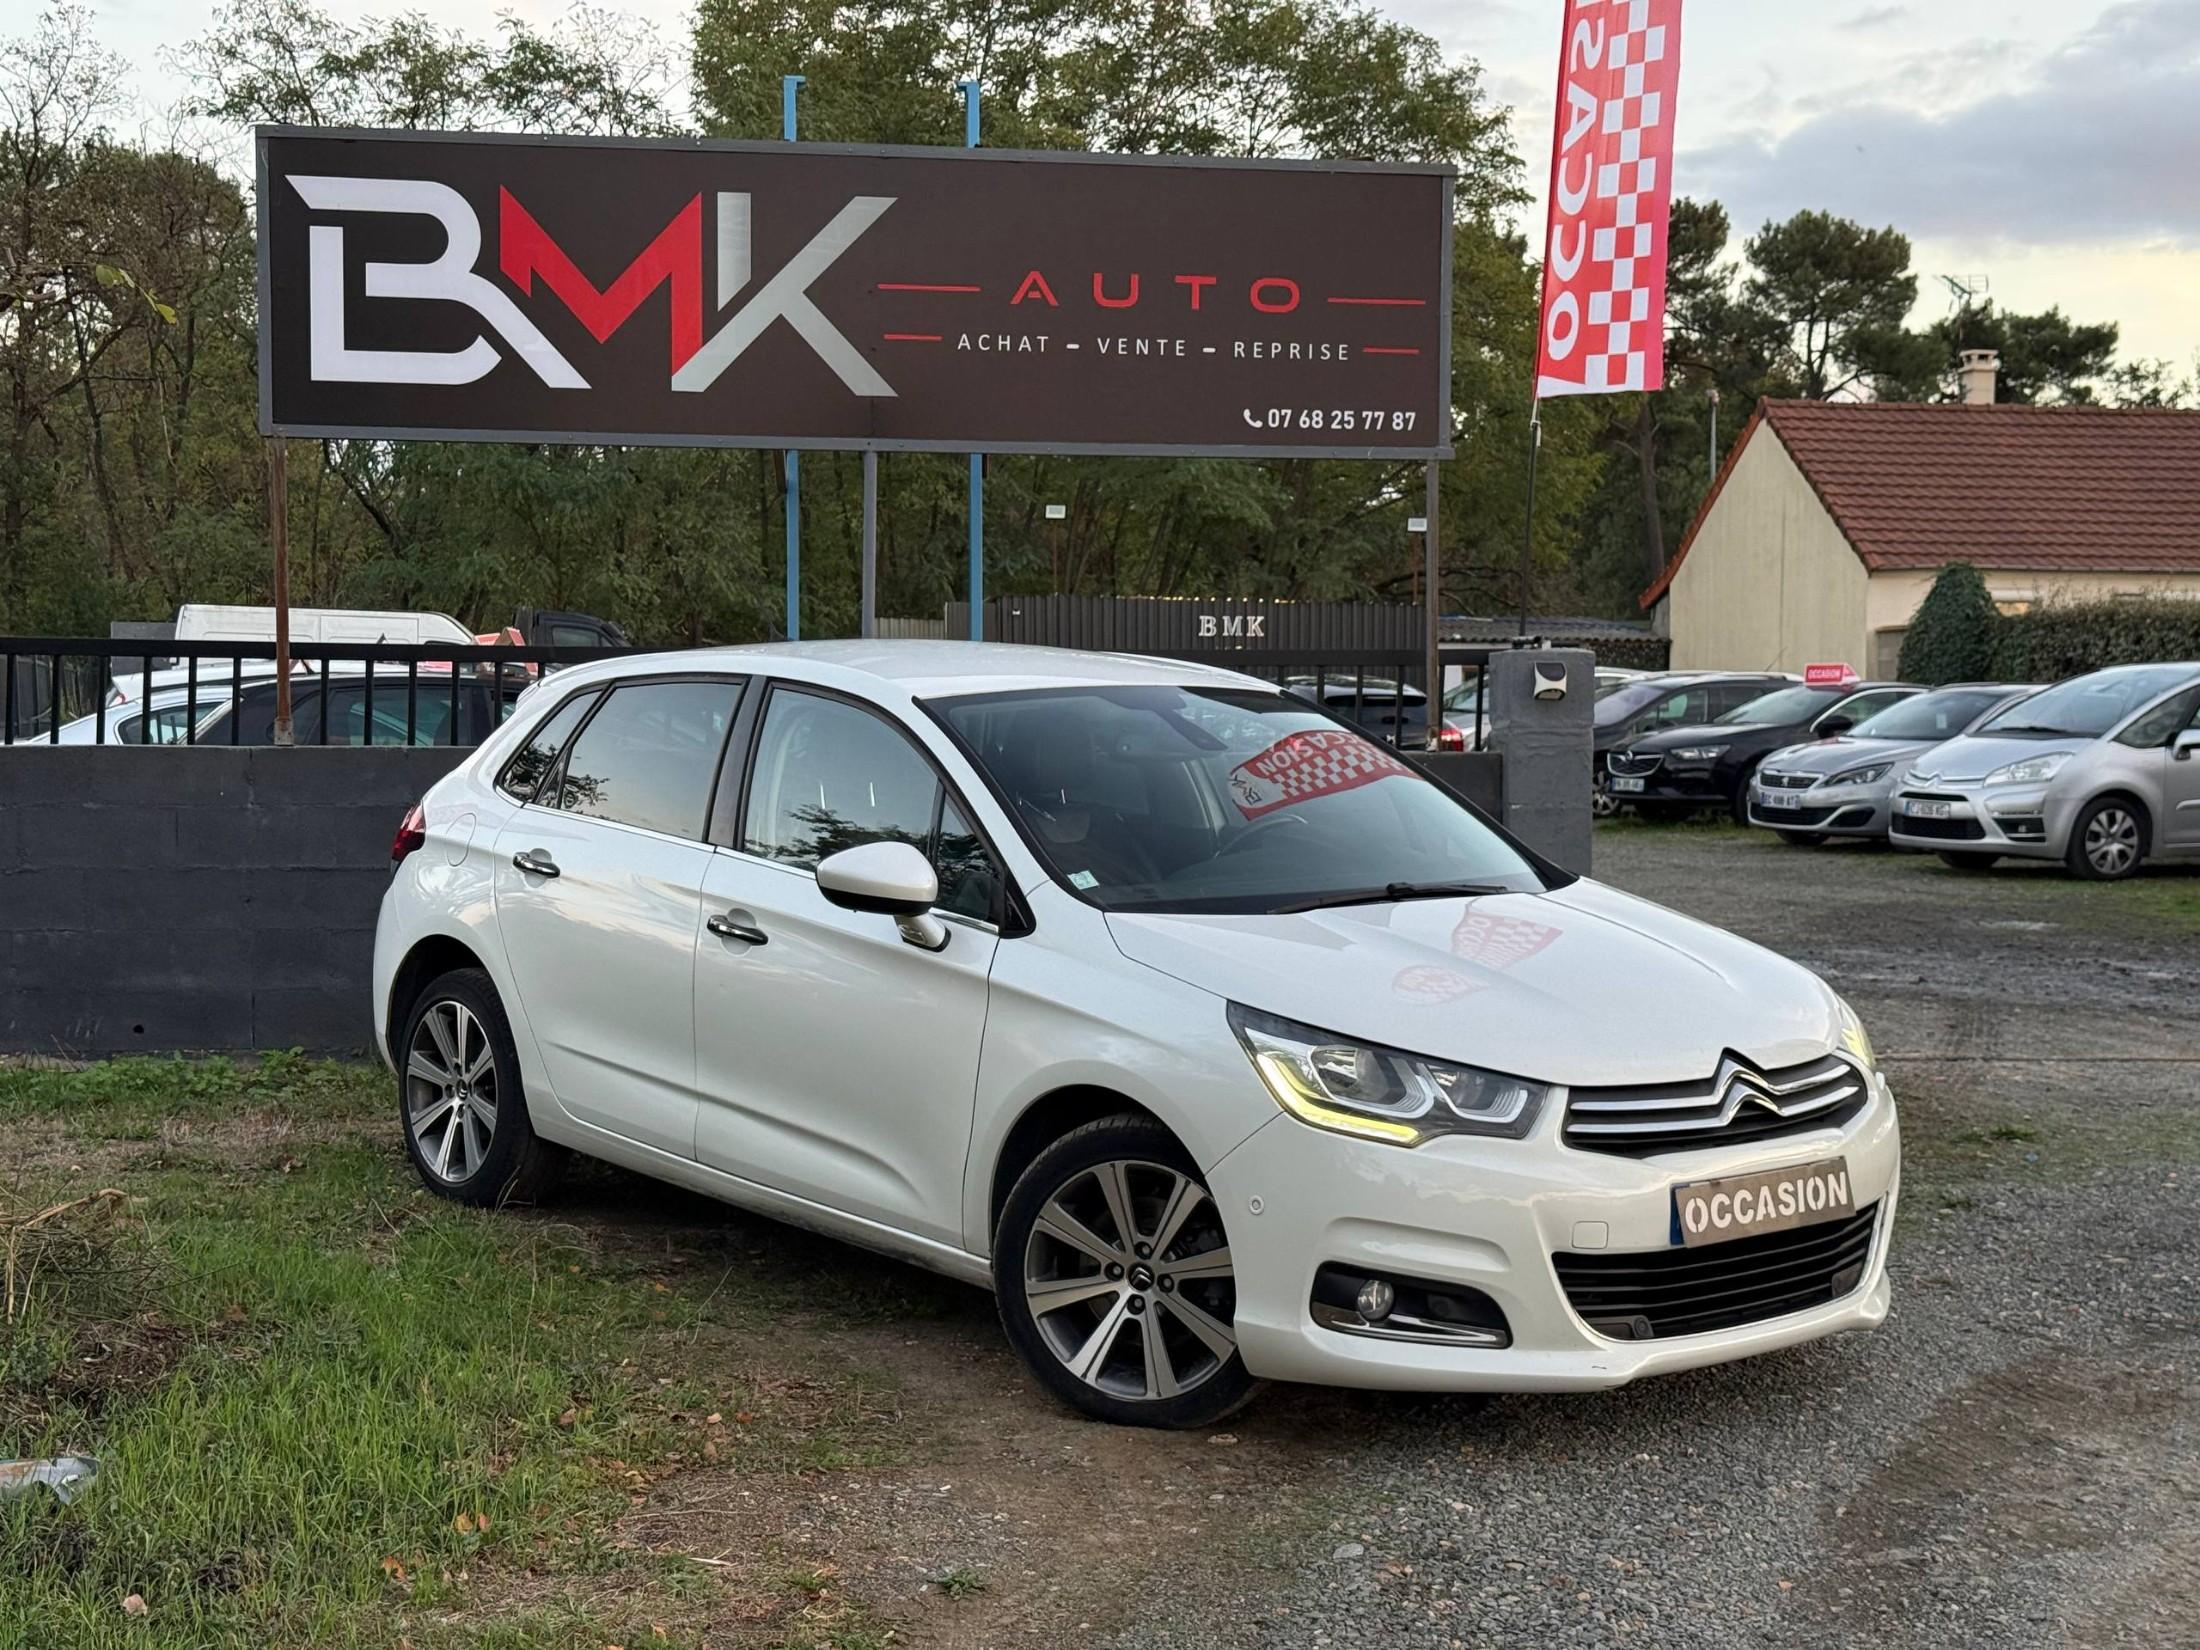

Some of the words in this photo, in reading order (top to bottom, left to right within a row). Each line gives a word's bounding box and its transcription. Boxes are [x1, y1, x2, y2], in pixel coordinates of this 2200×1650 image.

[285, 175, 898, 397] BMK
[1011, 270, 1301, 314] AUTO
[957, 333, 1049, 353] ACHAT
[1097, 337, 1186, 357] VENTE
[1234, 341, 1349, 361] REPRISE
[1267, 408, 1292, 428] 07
[1298, 409, 1324, 429] 68
[1330, 410, 1355, 430] 25
[1361, 410, 1385, 431] 77
[1391, 411, 1416, 431] 87
[1198, 615, 1265, 637] BMK
[1684, 1171, 1849, 1234] OCCASION
